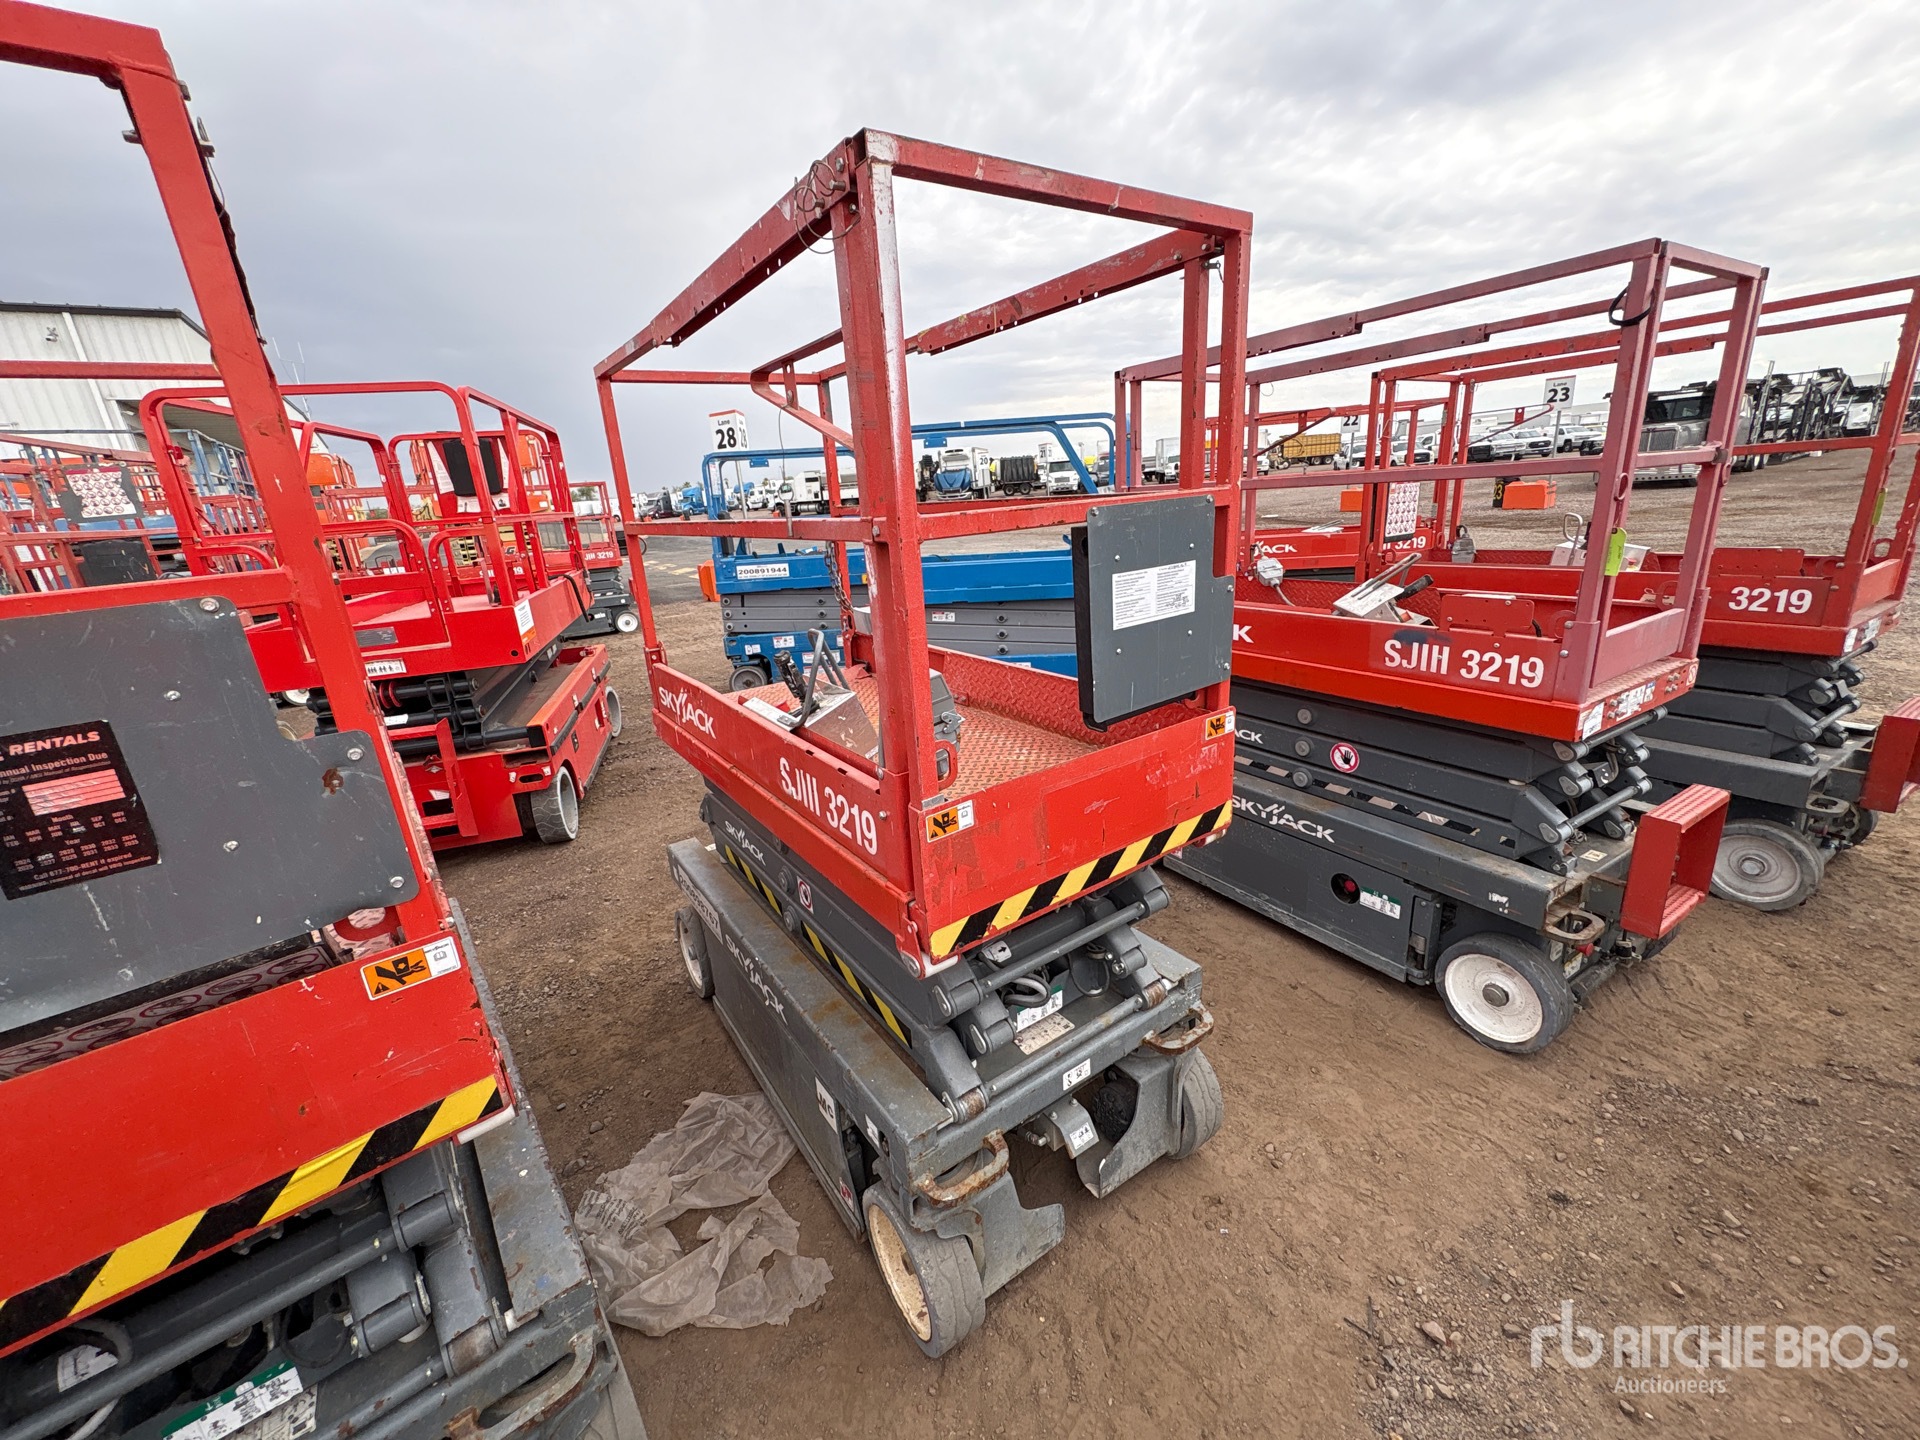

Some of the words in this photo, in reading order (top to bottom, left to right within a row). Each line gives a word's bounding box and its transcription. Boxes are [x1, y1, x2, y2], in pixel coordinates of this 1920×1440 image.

[1547, 387, 1570, 403] 23
[1343, 414, 1359, 427] 22
[715, 427, 737, 450] 28
[980, 456, 989, 466] 20
[597, 550, 614, 560] 3219
[1728, 586, 1813, 614] 3219
[1459, 649, 1545, 689] 3219
[658, 686, 717, 740] SKYJACK
[9, 731, 101, 756] RENTALS
[0, 765, 30, 778] nnual
[31, 756, 87, 771] Inspection
[88, 752, 109, 761] Due
[779, 756, 821, 817] SJIII
[824, 786, 878, 856] 3219
[725, 820, 766, 867] SKYJACK
[724, 933, 789, 1026] SKYJACK
